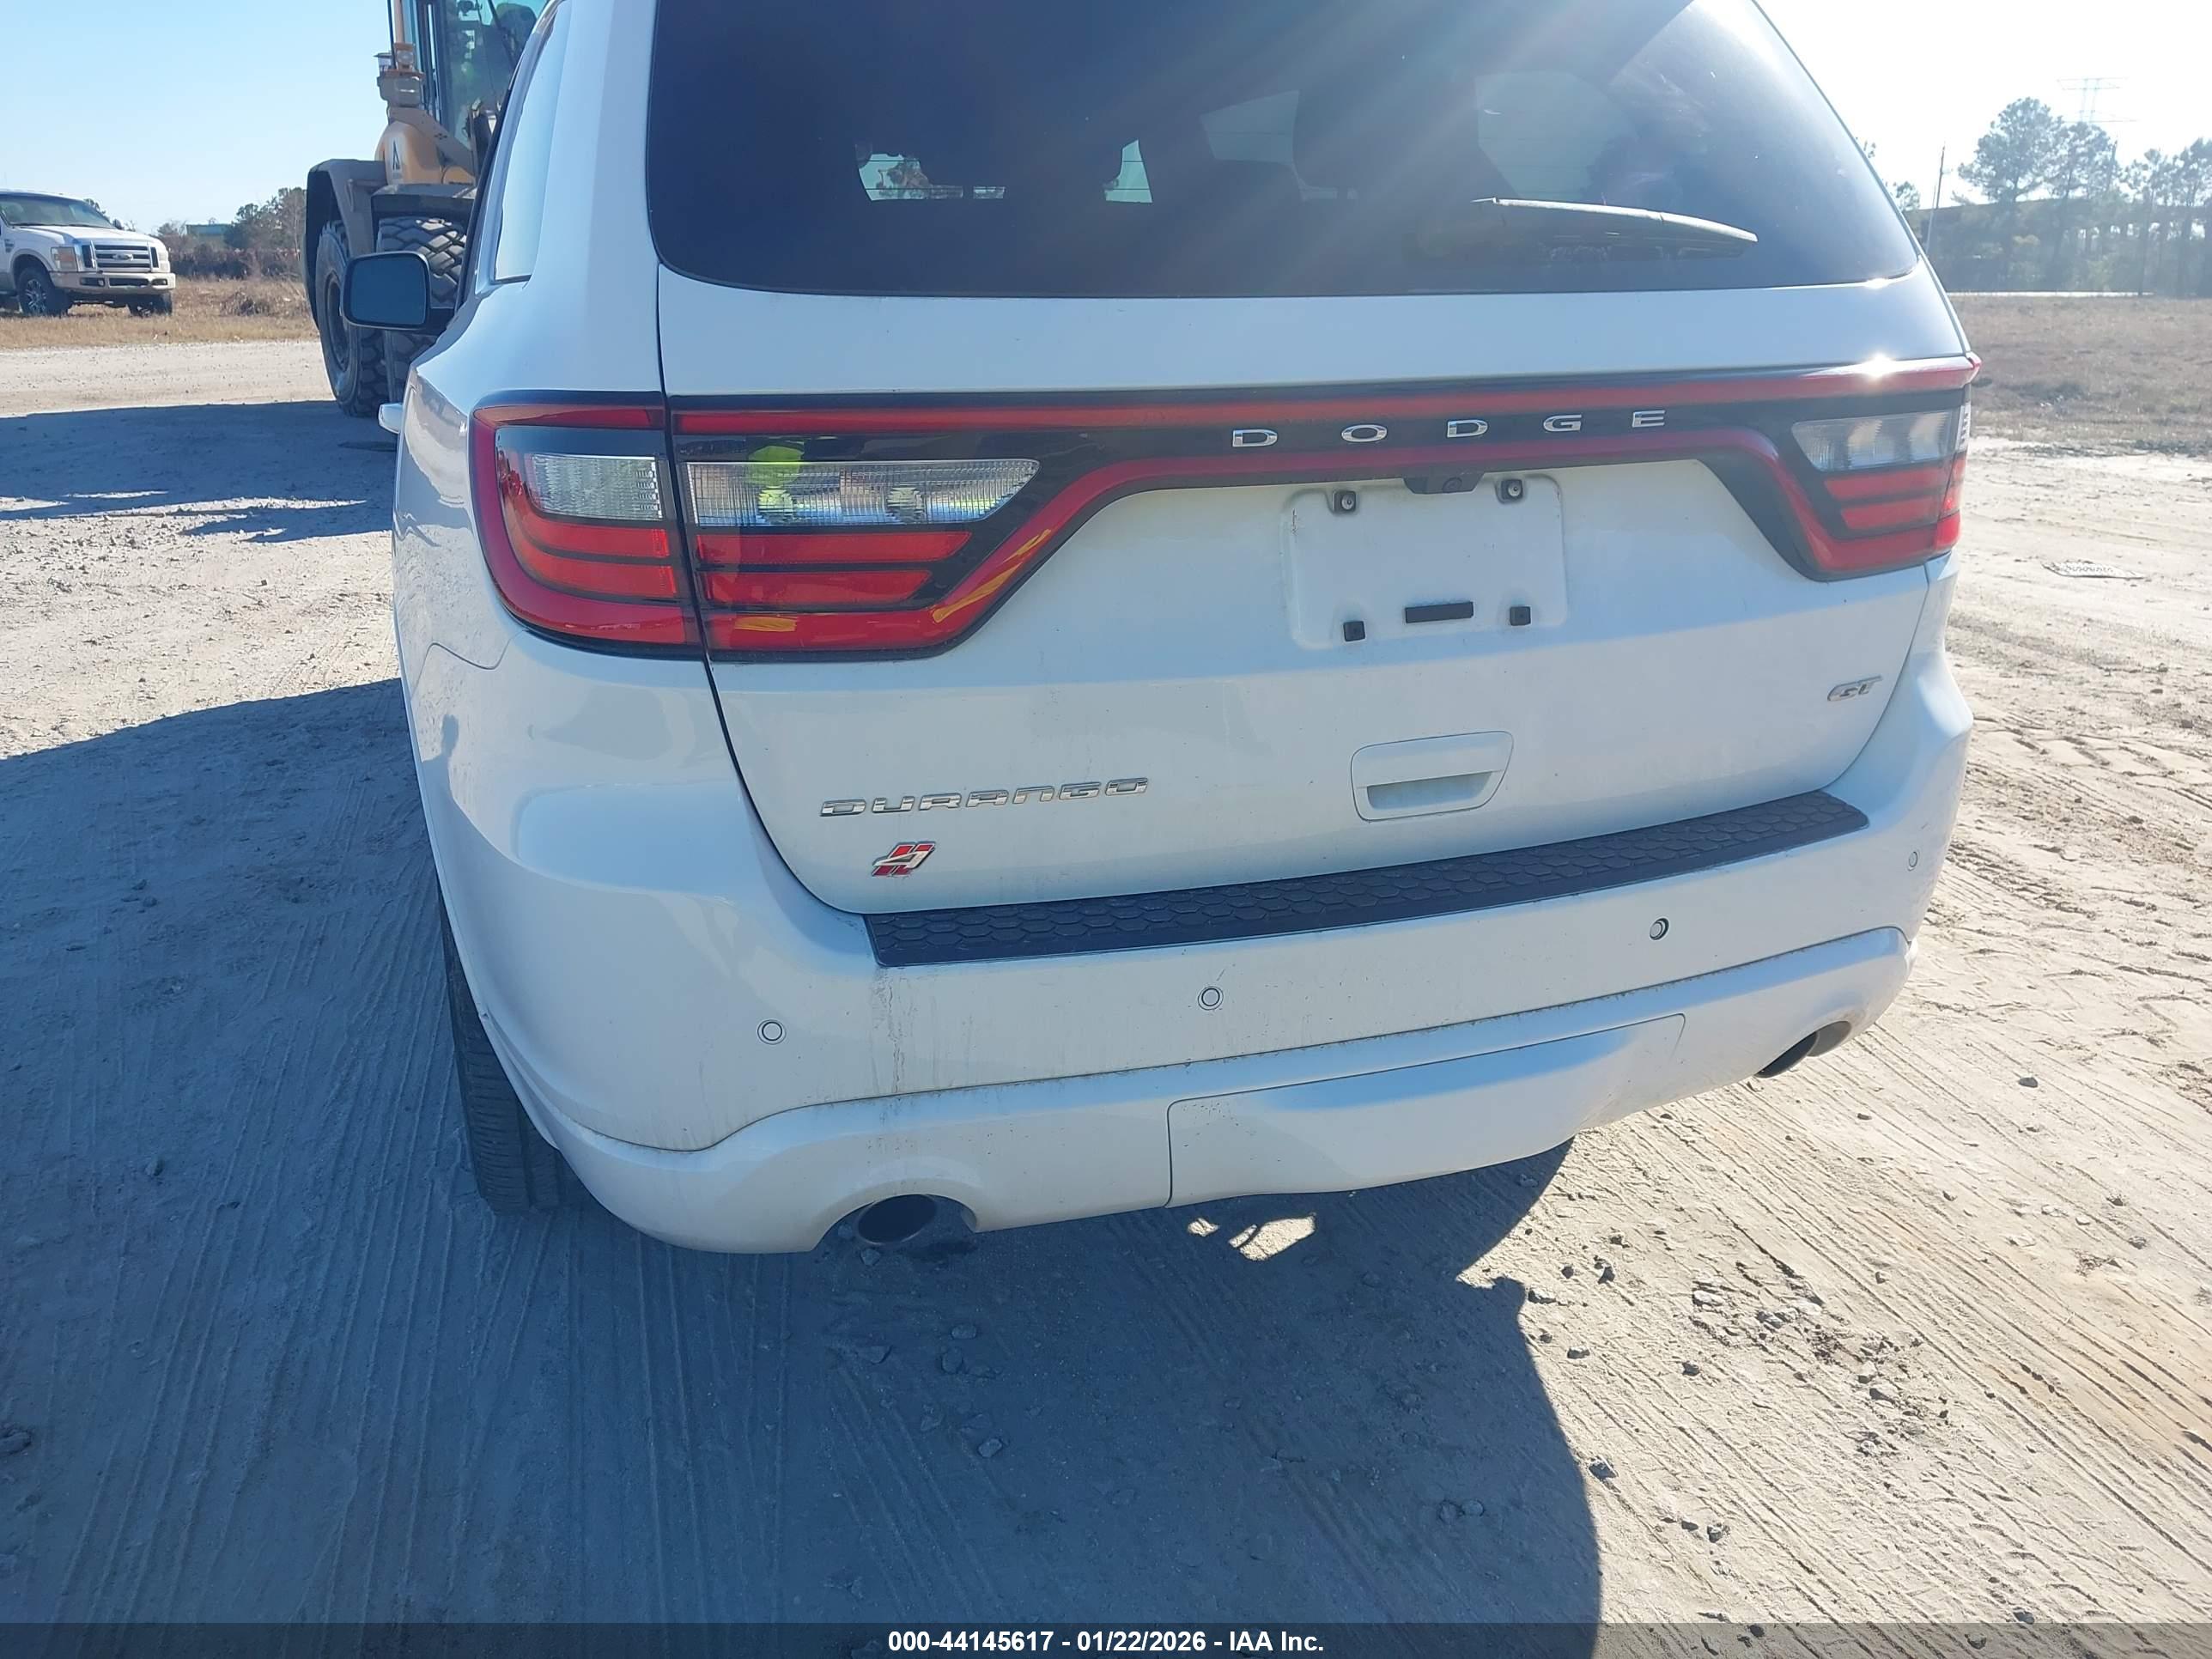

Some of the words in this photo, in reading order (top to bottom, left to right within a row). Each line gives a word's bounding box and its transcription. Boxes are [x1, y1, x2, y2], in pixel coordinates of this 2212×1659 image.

[1232, 410, 1666, 447] DODGE
[1826, 675, 1883, 702] GT
[819, 777, 1149, 817] DURANGO
